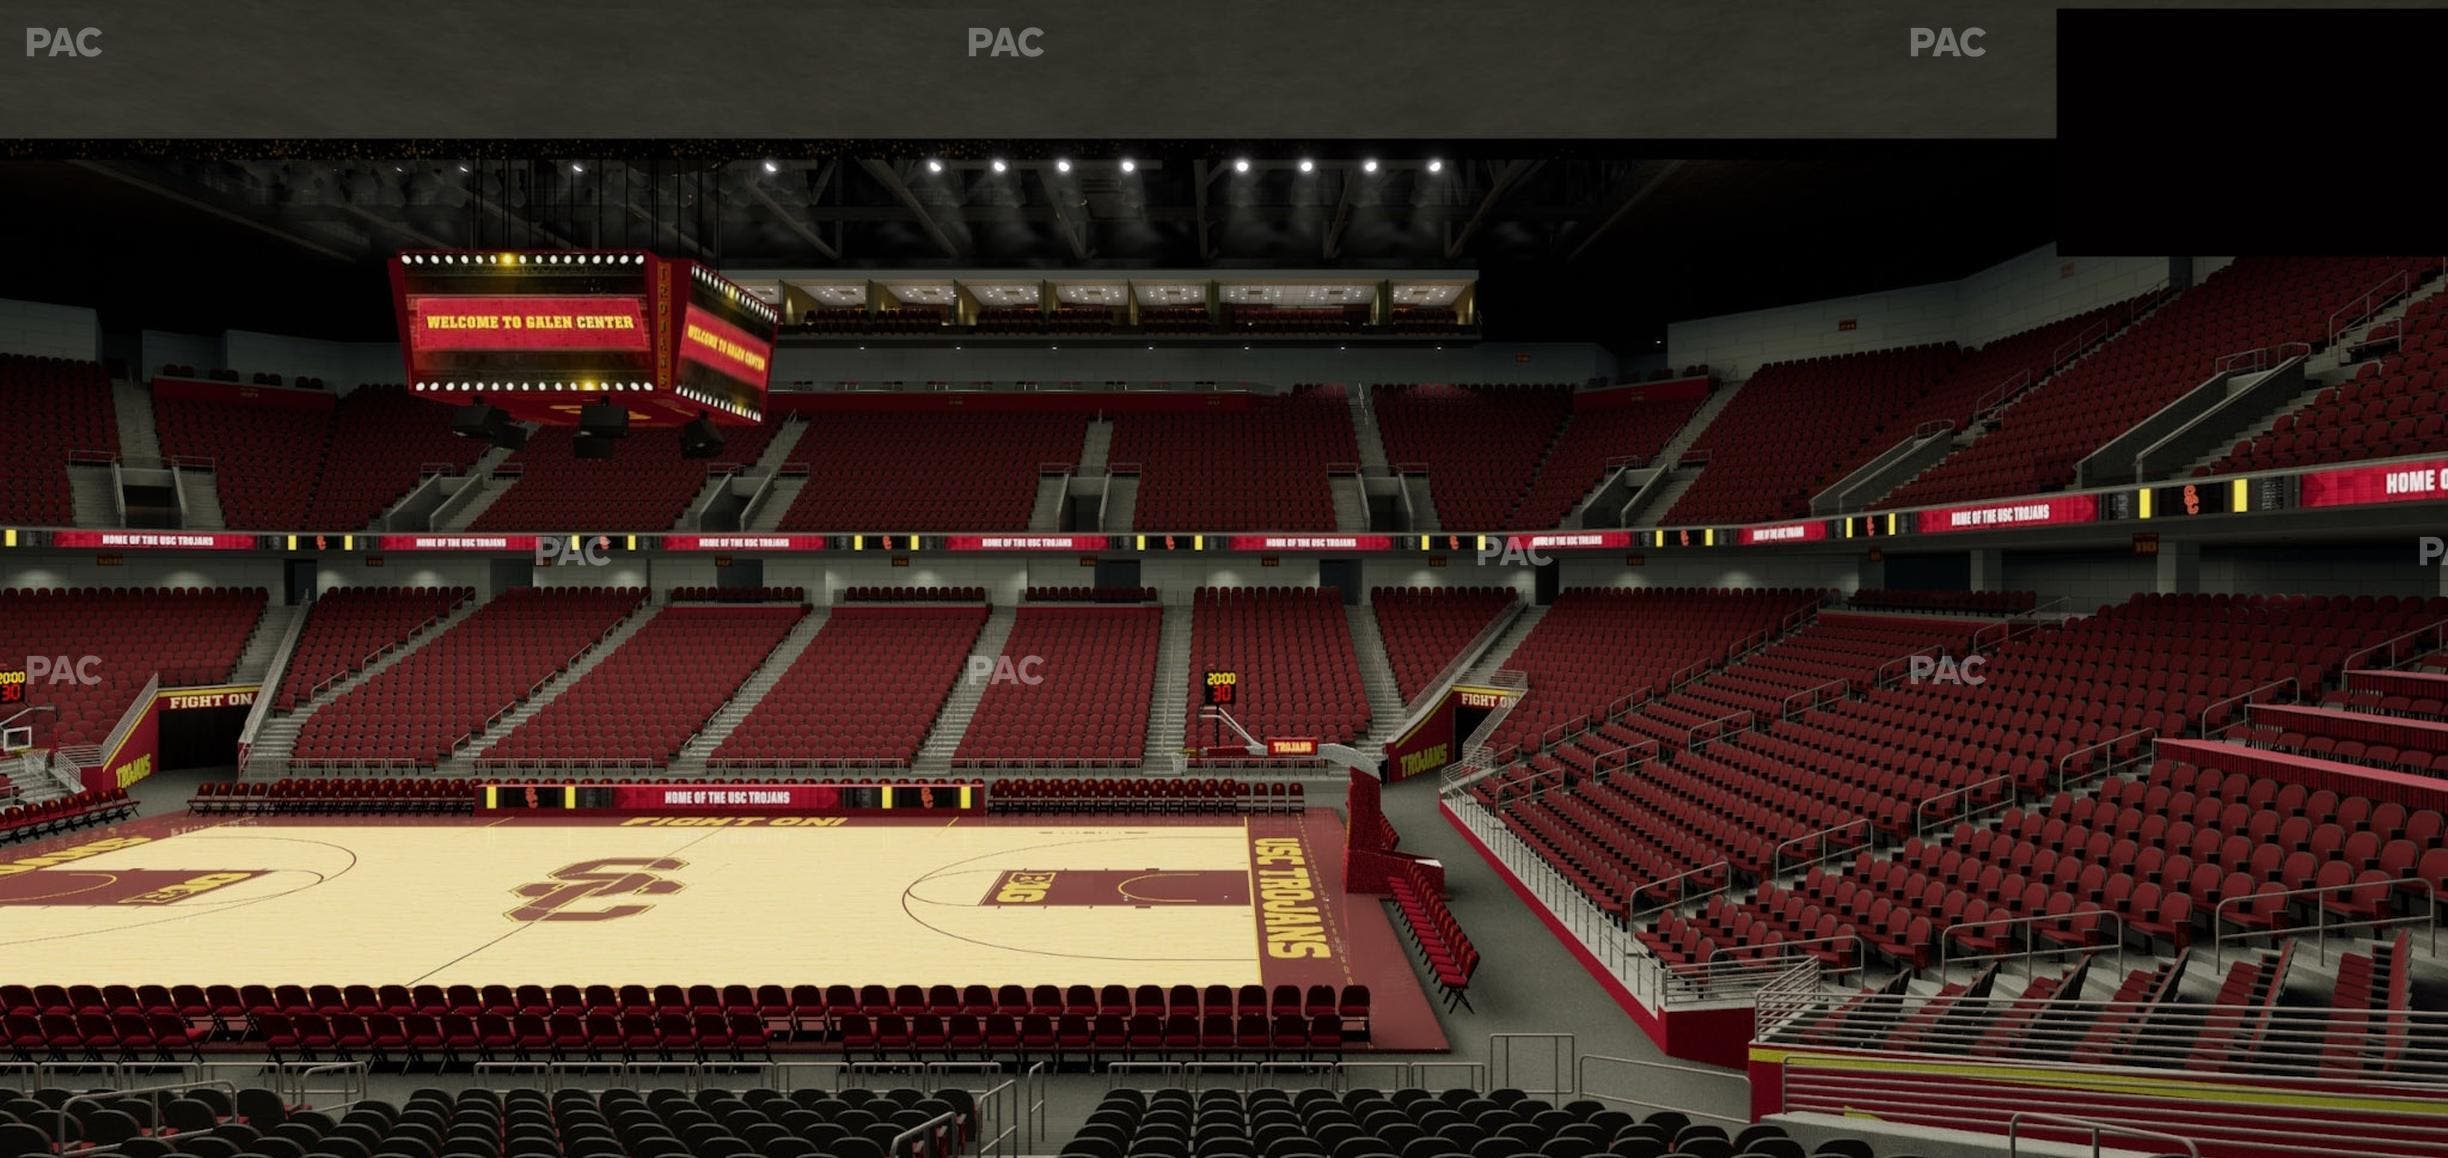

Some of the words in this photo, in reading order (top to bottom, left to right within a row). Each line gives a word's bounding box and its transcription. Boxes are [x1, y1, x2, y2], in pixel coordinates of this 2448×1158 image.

[427, 315, 499, 329] WELCOME
[503, 316, 522, 329] TO
[526, 316, 573, 329] GALEN
[576, 315, 634, 329] CENTER
[687, 324, 718, 349] WELCOME
[2386, 469, 2435, 494] HOME
[1952, 512, 1971, 526] HOME
[1972, 510, 1980, 524] OF
[1982, 509, 1996, 523] THE
[1997, 507, 2012, 522] USC
[2014, 504, 2049, 521] TROJANS
[102, 535, 128, 544] HOME
[129, 535, 141, 545] OF
[142, 535, 158, 545] THE
[160, 536, 176, 546] USC
[178, 536, 214, 546] TROJANS
[2, 685, 20, 702] 30
[169, 694, 224, 710] FIGHT
[228, 693, 254, 706] ON
[1214, 685, 1232, 702] 30
[1461, 693, 1497, 707] FIGHT
[1273, 742, 1312, 753] TROJANS
[1400, 742, 1448, 778] TROJANS
[115, 752, 151, 789] TROJANS
[664, 791, 692, 804] HOME
[694, 791, 706, 804] OF
[708, 791, 726, 804] THE
[728, 791, 747, 804] USC
[748, 791, 790, 804] TROJANS
[619, 817, 766, 827] FIGHT
[768, 817, 849, 827] ON!
[1255, 838, 1305, 865] USC
[1259, 868, 1331, 958] TROJANS
